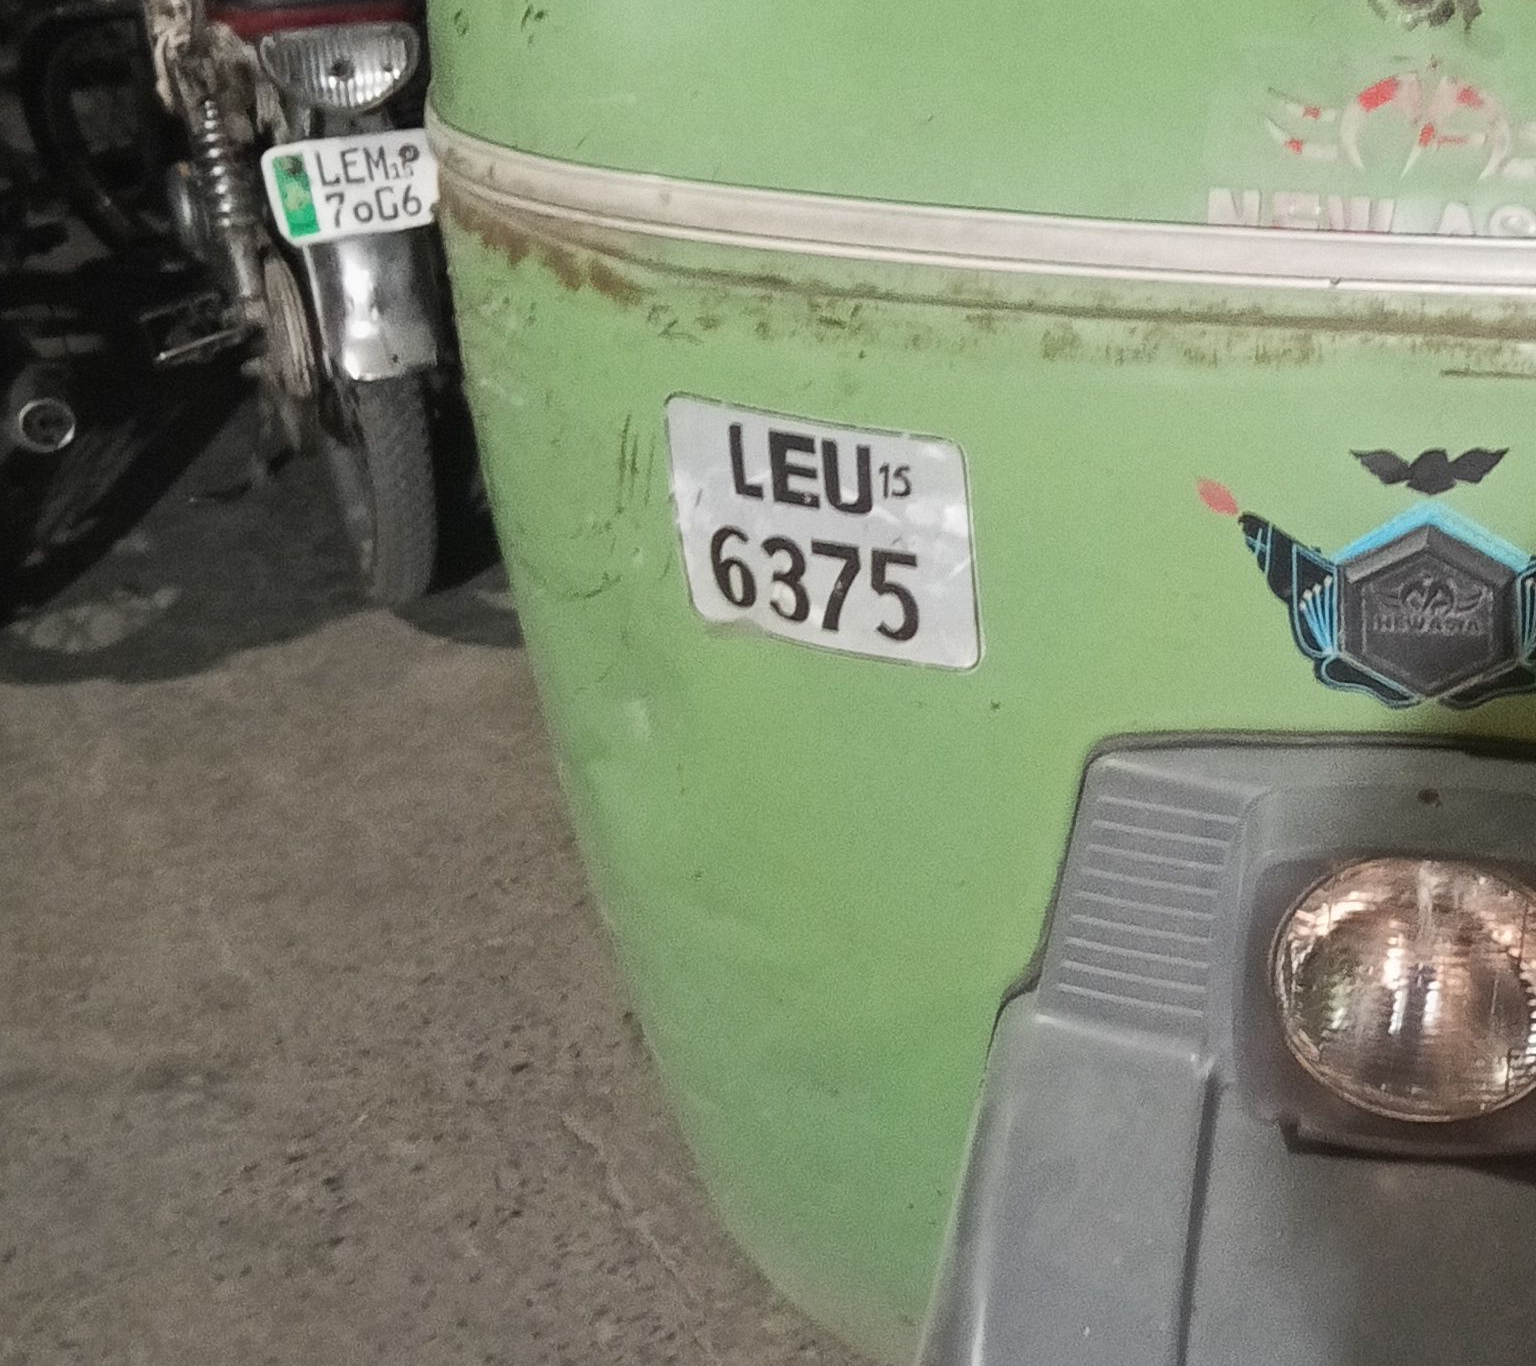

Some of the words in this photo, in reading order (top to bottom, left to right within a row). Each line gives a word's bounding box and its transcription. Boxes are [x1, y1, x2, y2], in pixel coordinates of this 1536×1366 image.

[315, 144, 390, 186] LEM
[727, 421, 873, 515] LEU
[710, 525, 920, 642] 6375
